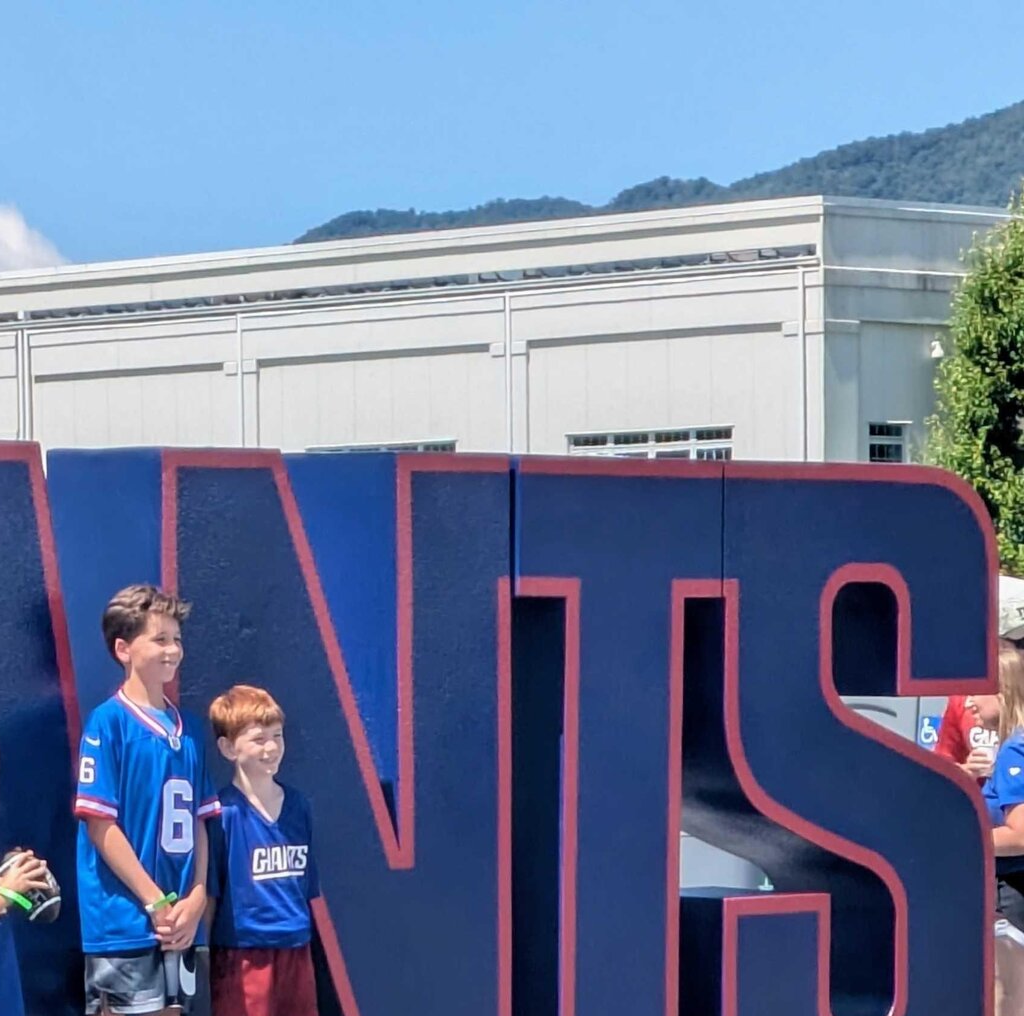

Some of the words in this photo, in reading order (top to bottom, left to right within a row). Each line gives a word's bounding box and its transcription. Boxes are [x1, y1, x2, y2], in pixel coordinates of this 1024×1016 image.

[79, 757, 95, 783] 6
[161, 778, 194, 853] 6
[252, 845, 309, 873] GIANTS
